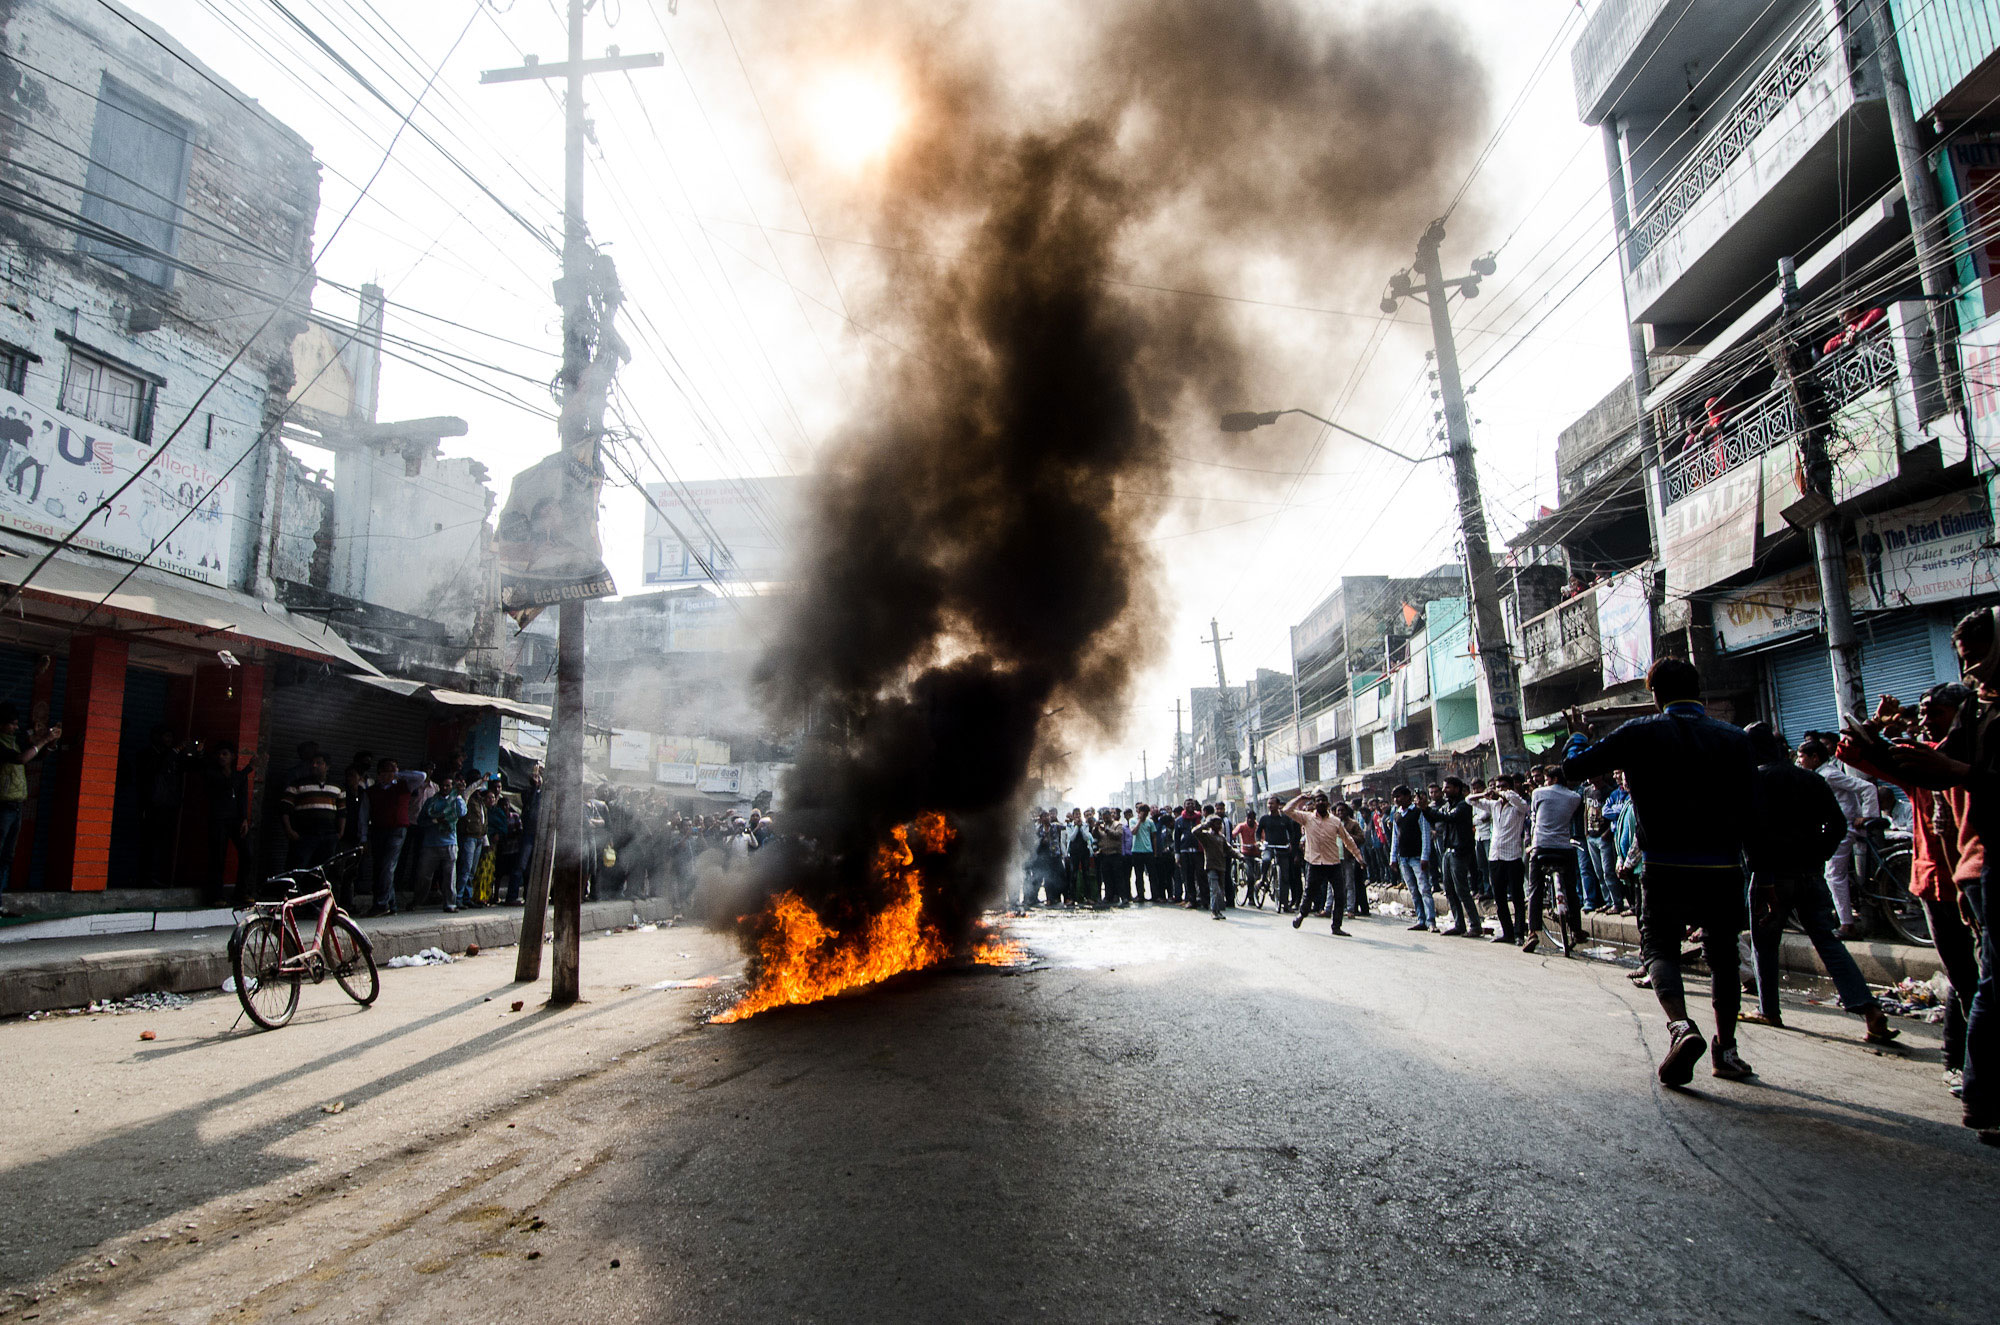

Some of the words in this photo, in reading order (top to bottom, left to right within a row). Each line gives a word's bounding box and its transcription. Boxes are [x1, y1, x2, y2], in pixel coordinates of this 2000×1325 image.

[137, 447, 228, 492] collection
[13, 517, 54, 537] road
[158, 558, 209, 583] birgunj
[1884, 529, 1907, 551] The
[1905, 518, 1942, 546] Great
[1950, 539, 1973, 554] and
[560, 579, 616, 599] COLLEGE
